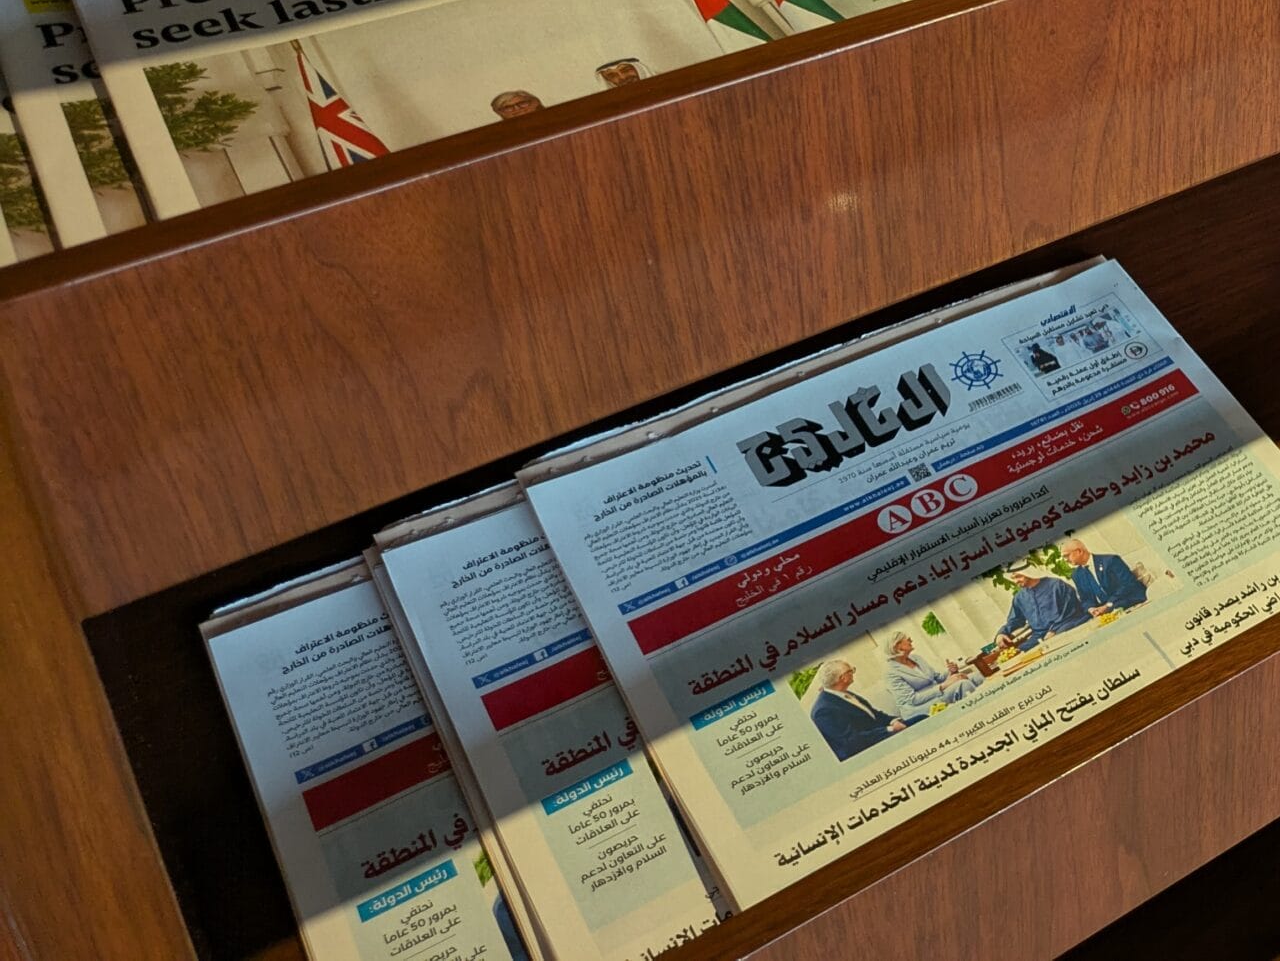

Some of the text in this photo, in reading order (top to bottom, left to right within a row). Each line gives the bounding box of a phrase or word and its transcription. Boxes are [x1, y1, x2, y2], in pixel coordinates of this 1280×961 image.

[132, 8, 265, 49] seek
[1140, 384, 1175, 405] 800 916
[1173, 432, 1215, 461] محمد
[1121, 464, 1154, 487] زايد
[1154, 455, 1174, 473] بن
[593, 471, 707, 522] بالمؤهلات الصادرة من الخارج
[603, 460, 702, 505] تحديث منظومة الاعتراف
[1058, 482, 1122, 513] وحاكمة
[867, 485, 1050, 583] أكدا ضرورة تعزيز أسباب الاستقرار الإقليمي
[994, 505, 1062, 548] كومنولث
[893, 575, 928, 605] دعم
[1240, 582, 1268, 599] راشد
[1267, 575, 1280, 587] بن
[847, 594, 888, 626] مسار
[1184, 606, 1212, 631] قانون
[1210, 604, 1260, 633] الحكومية
[1213, 595, 1242, 617] يصدر
[784, 611, 842, 656] السلام
[1180, 637, 1200, 658] دبي
[1201, 627, 1214, 646] في
[759, 641, 780, 672] في
[688, 653, 754, 695] المنطقة
[738, 687, 767, 706] رئيس
[729, 712, 758, 732] نحتفي
[738, 725, 753, 736] 50
[754, 713, 780, 731] بمرور
[541, 731, 612, 776] المنطقة
[724, 723, 784, 756] على العلاقات
[598, 767, 630, 791] رئيس
[773, 669, 1141, 867] سلطان يفتتح المباني الجديدة لمدينة الخدمات الإنسانية
[361, 813, 468, 879] في المنطقة
[414, 868, 449, 892] رئيس
